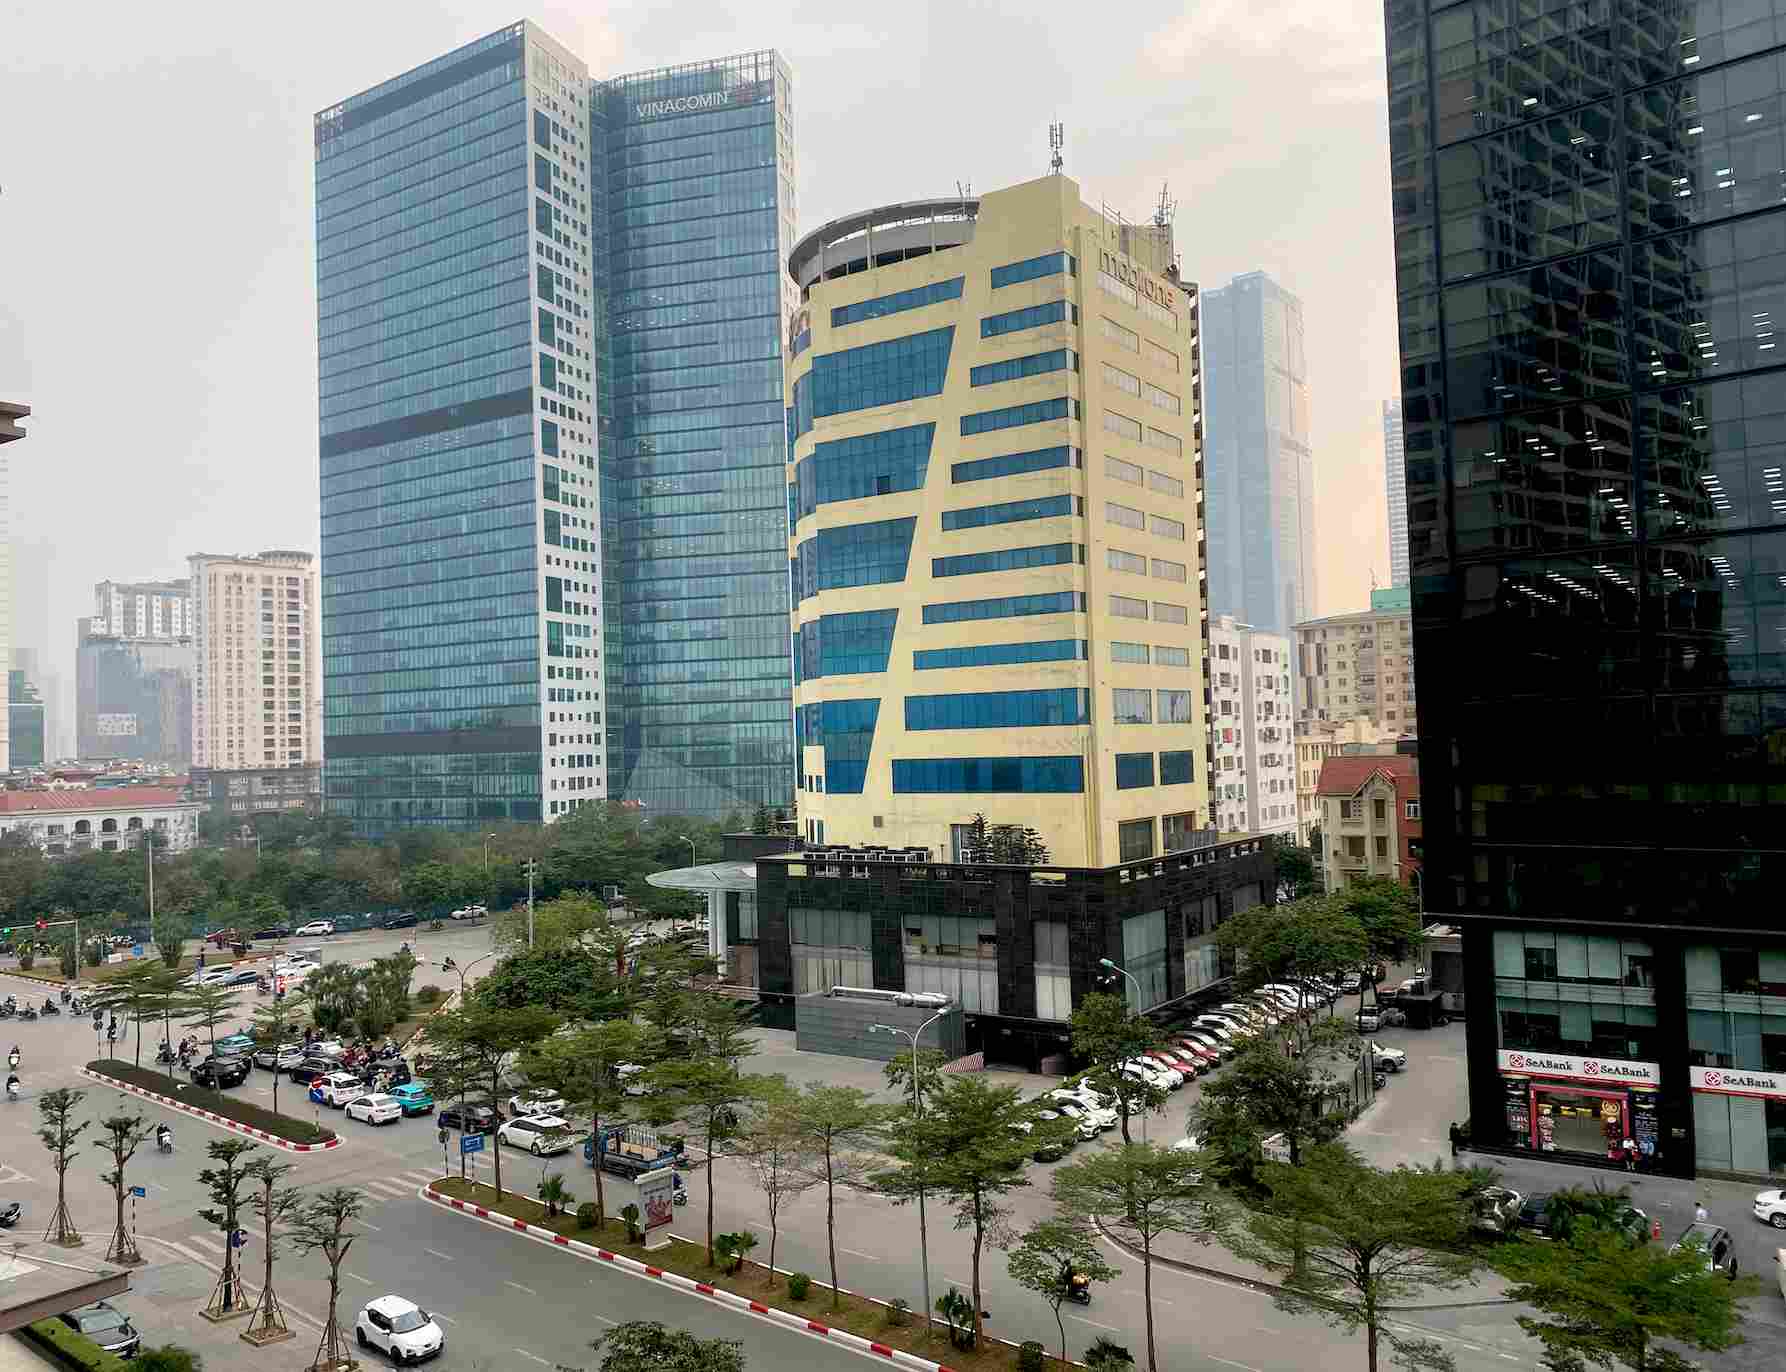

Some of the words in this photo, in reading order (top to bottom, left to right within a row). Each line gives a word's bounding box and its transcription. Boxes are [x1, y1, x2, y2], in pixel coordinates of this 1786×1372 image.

[636, 91, 728, 117] VINACOMIN
[1525, 1057, 1573, 1071] SeABank
[1600, 1064, 1650, 1078] SeABank
[1722, 1075, 1777, 1089] SeABank
